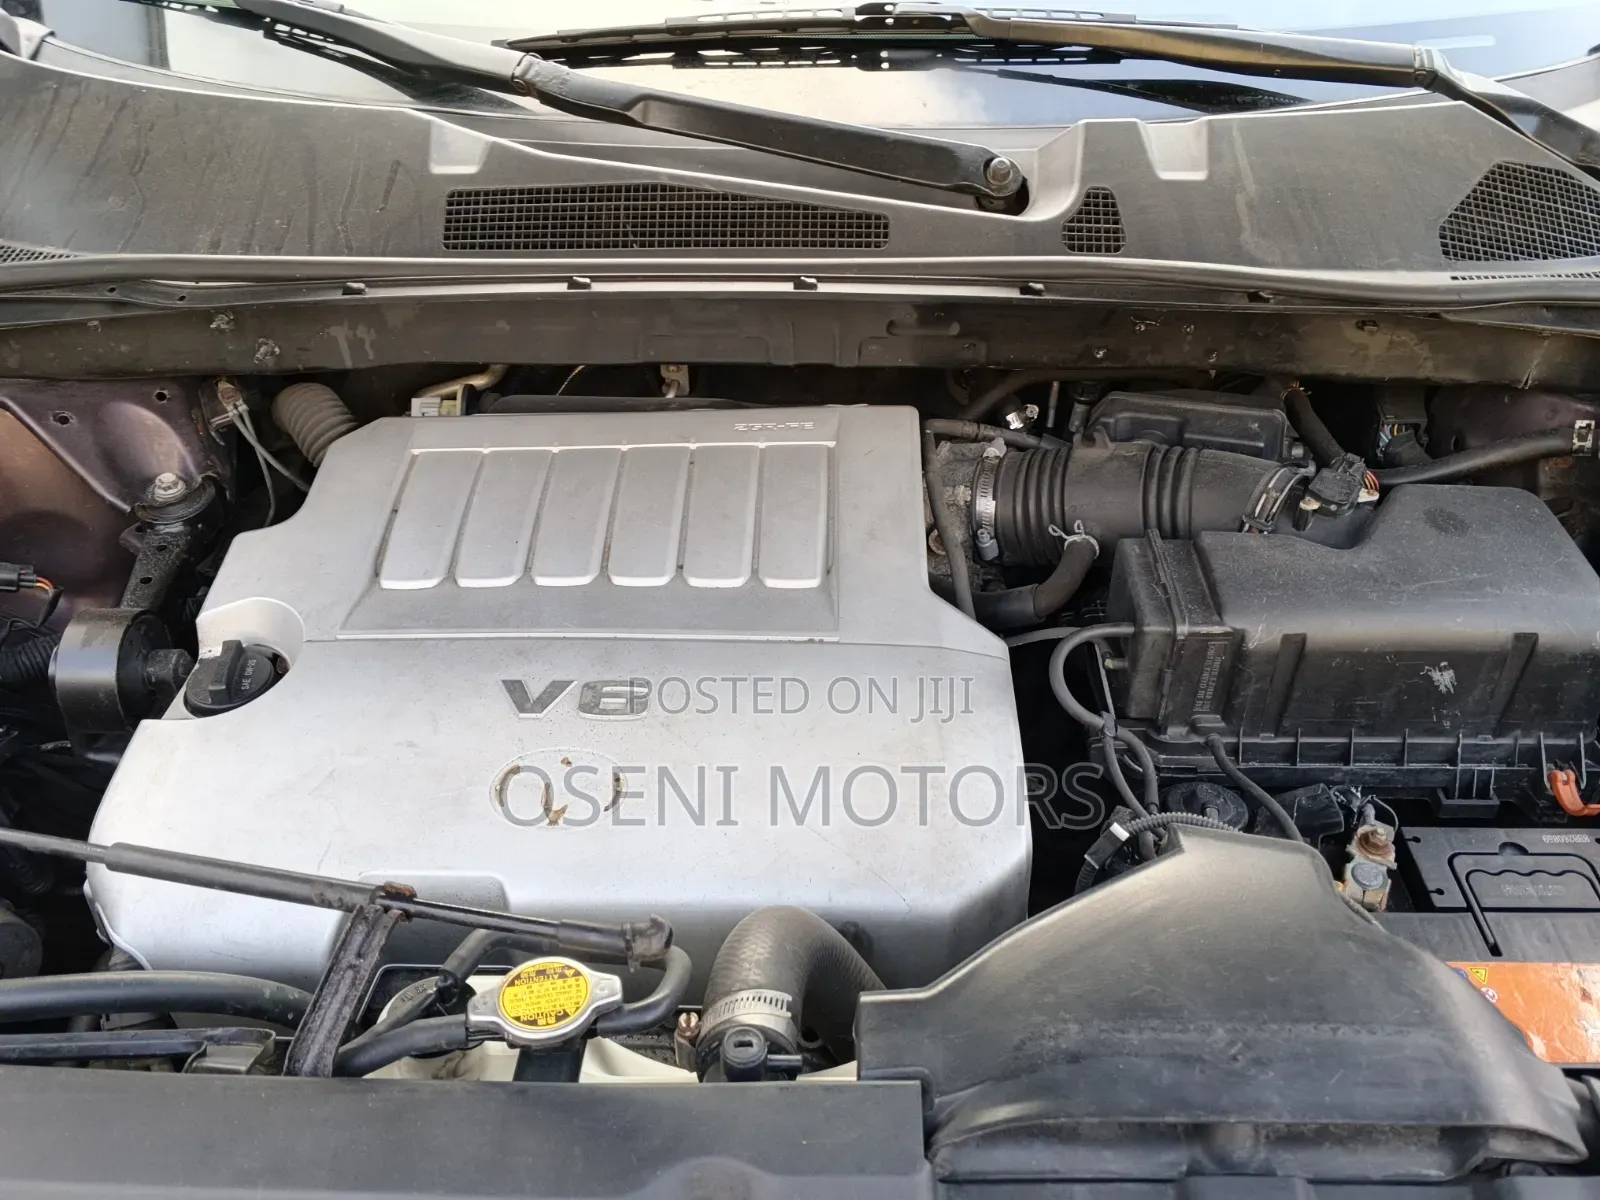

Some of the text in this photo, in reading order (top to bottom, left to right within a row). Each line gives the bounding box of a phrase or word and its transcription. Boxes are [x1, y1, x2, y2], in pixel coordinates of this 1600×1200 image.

[241, 677, 252, 690] SAE
[501, 679, 650, 721] V6
[514, 974, 560, 987] ATTENTION
[520, 1009, 564, 1022] CAUTION
